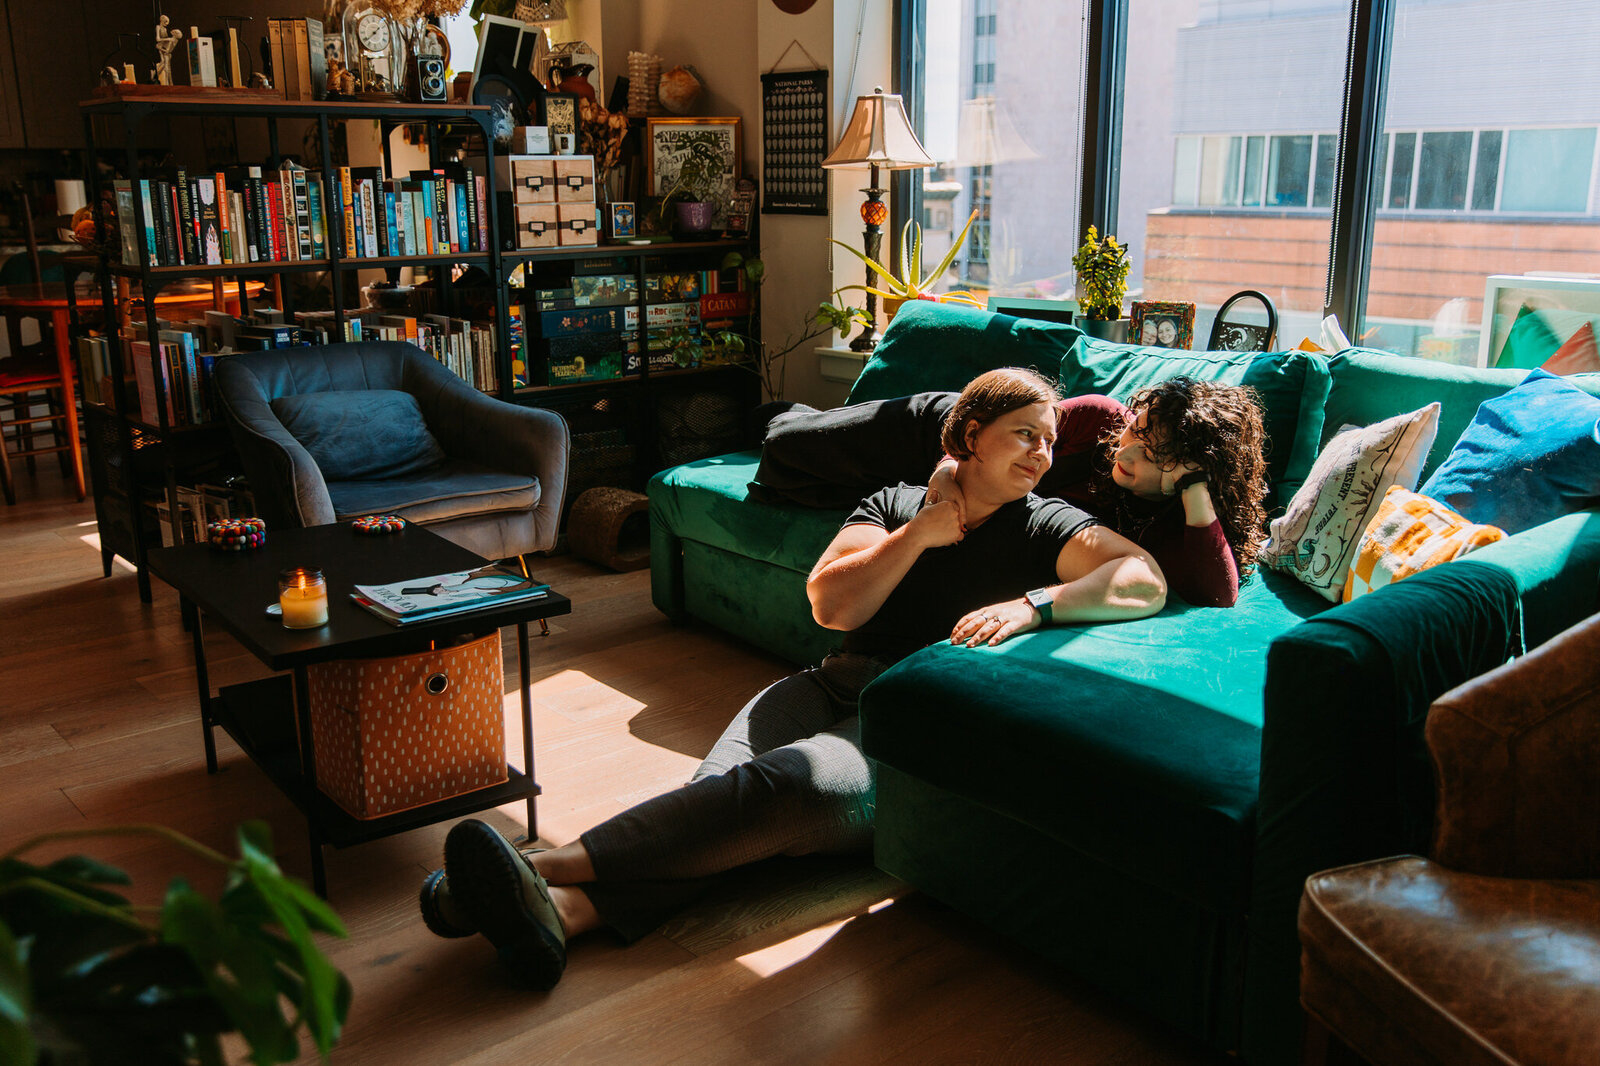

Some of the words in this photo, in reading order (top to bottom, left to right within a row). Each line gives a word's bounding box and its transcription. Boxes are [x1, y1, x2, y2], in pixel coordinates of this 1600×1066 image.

[435, 181, 440, 190] WE
[181, 189, 190, 219] BARDUGO
[654, 308, 668, 317] RIDE
[707, 299, 736, 312] CATAN
[1338, 461, 1358, 502] PRESENT
[1315, 503, 1338, 536] FUTURE
